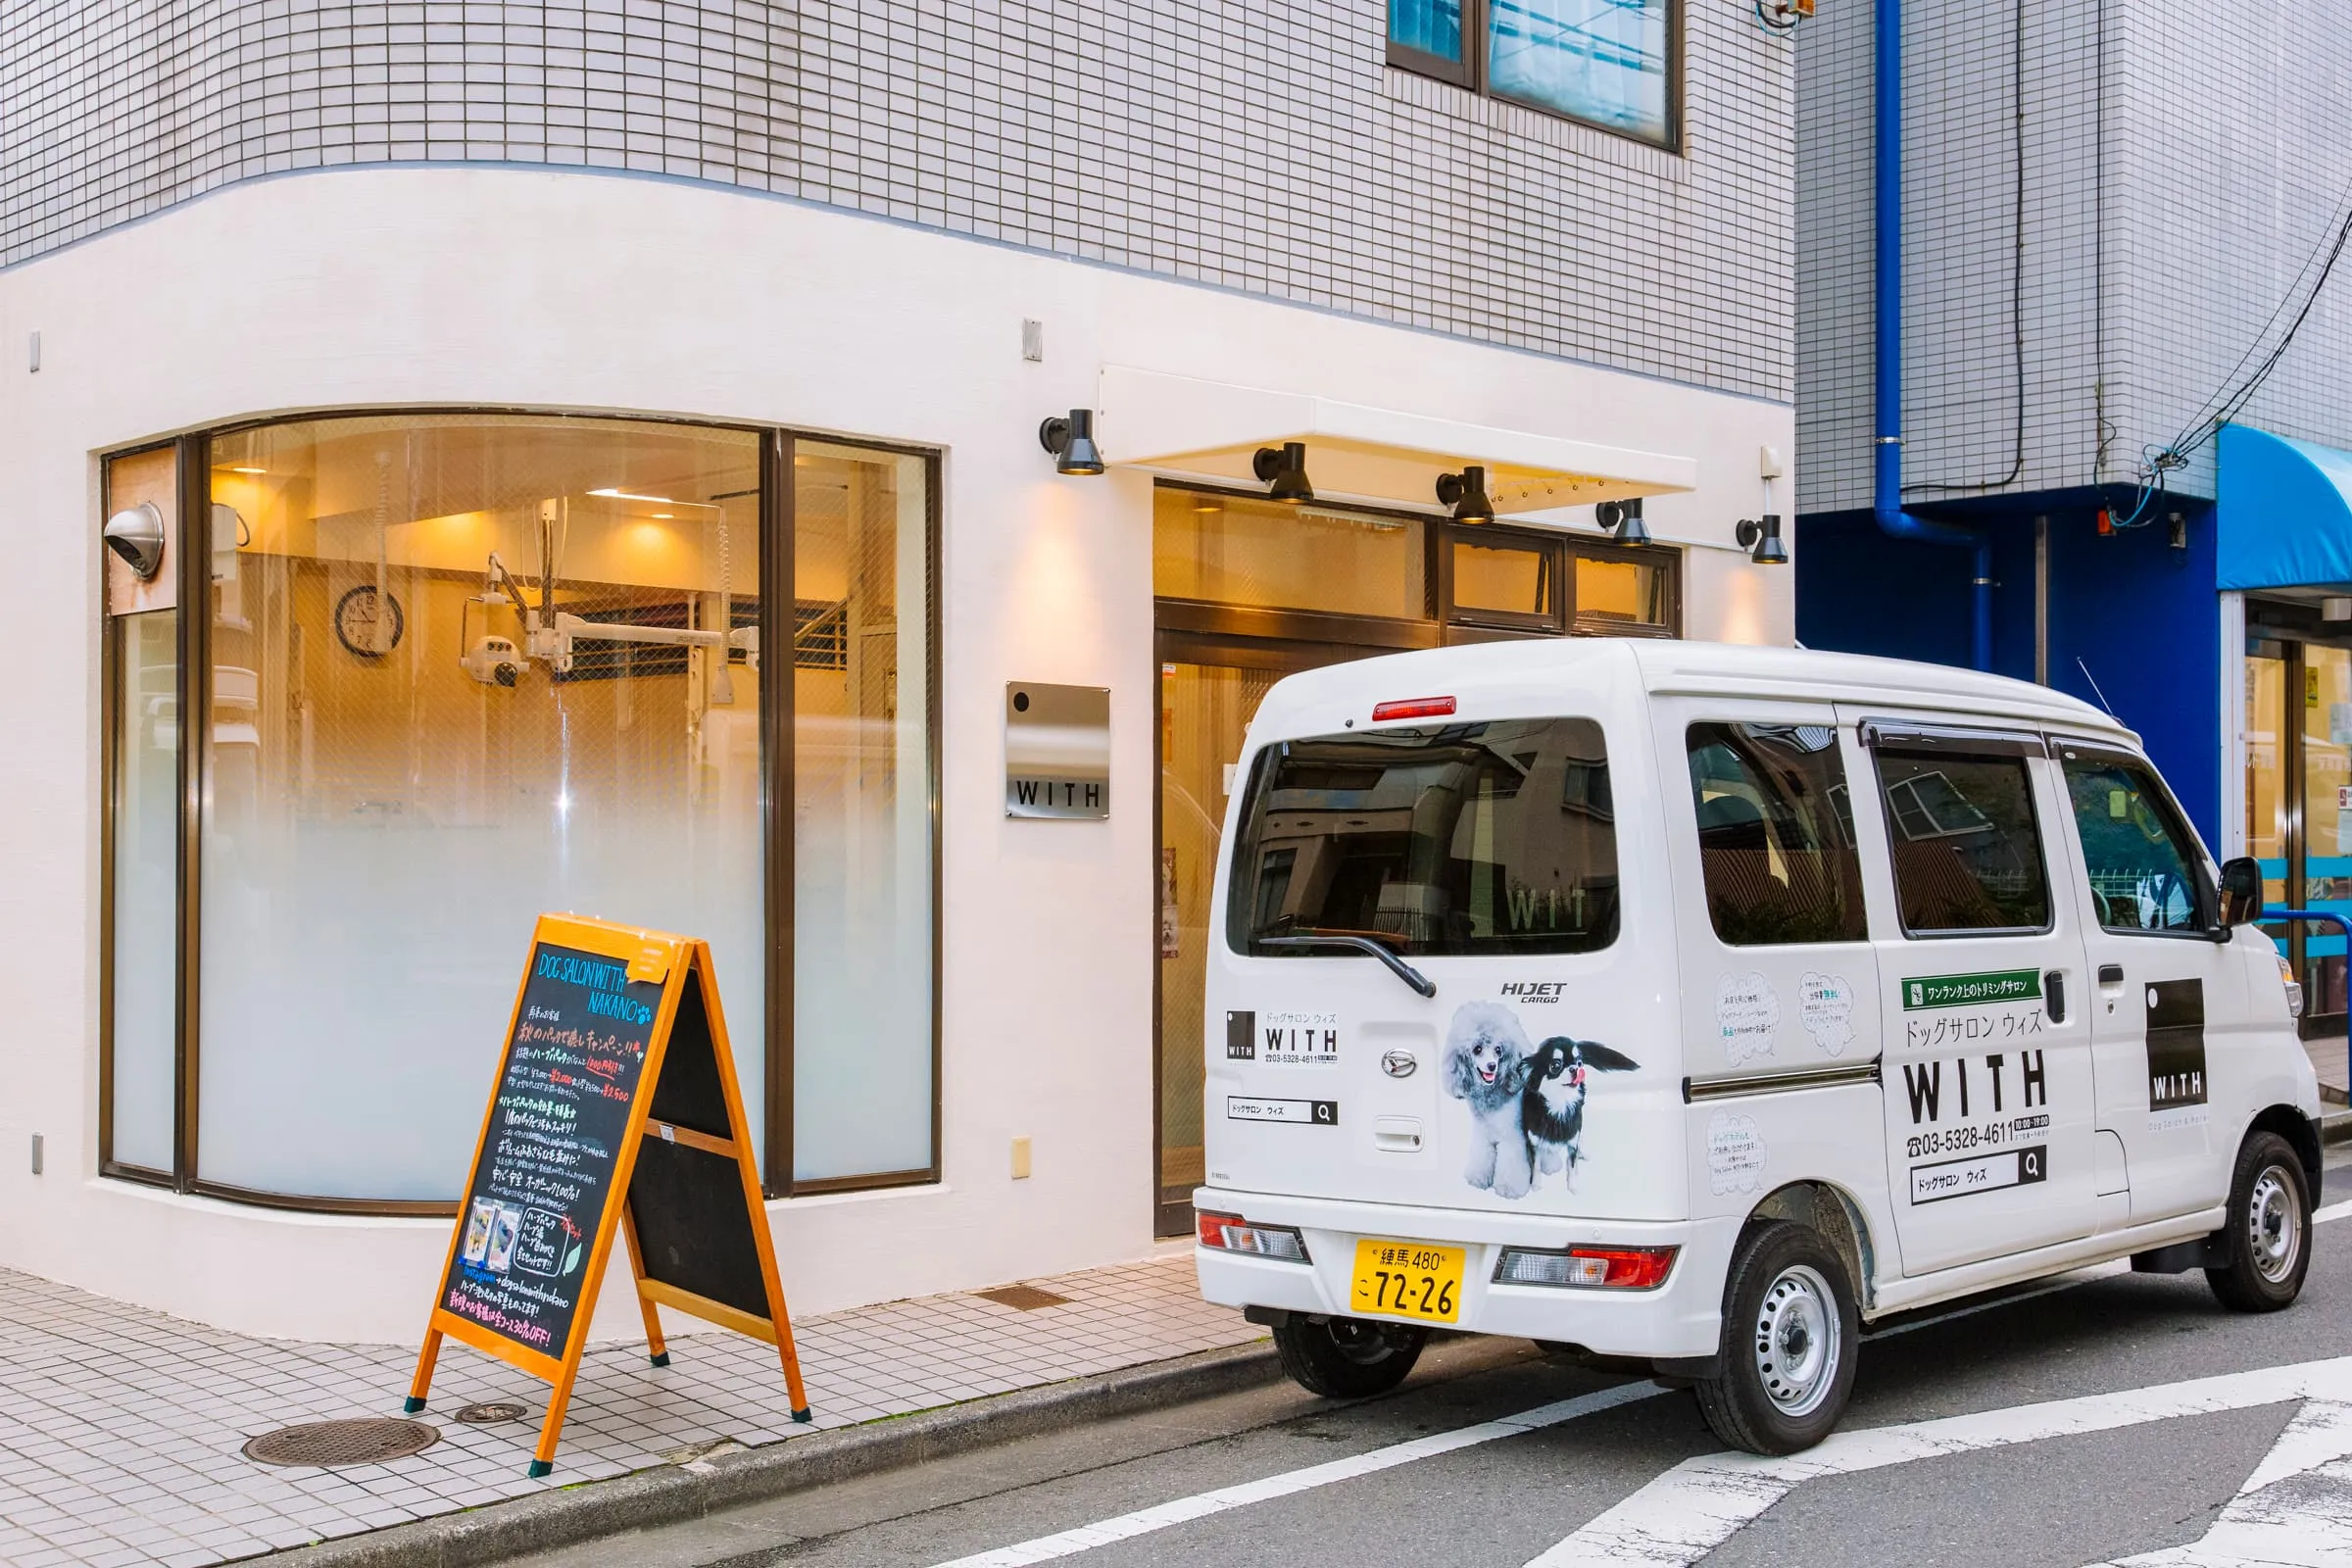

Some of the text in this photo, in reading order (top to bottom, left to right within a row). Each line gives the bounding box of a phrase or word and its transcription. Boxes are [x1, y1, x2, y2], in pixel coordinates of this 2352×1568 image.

[1017, 780, 1100, 808] WITH
[594, 962, 626, 993] WITH
[1500, 983, 1568, 996] HIJET
[1928, 980, 2028, 1001] ワンランク上のトリミングサロン
[587, 991, 638, 1021] NAKANO
[1267, 1012, 1337, 1024] ドッグサロン ウィズ
[1266, 1028, 1337, 1052] WITH
[1906, 1008, 2042, 1048] ドッグサロン ウィズ
[1229, 1046, 1252, 1056] WITH
[1273, 1054, 1318, 1063] 03-5328-4611
[1903, 1049, 2046, 1125] WITH
[2154, 1071, 2201, 1100] WITH
[1233, 1104, 1285, 1115] ドッグサロン ウィズ
[1923, 1120, 2014, 1155] 03-5328-4611
[1919, 1167, 1987, 1193] ドッグサロン ウィズ
[1380, 1248, 1441, 1271] 練馬 480
[1358, 1271, 1454, 1315] こ 72-26
